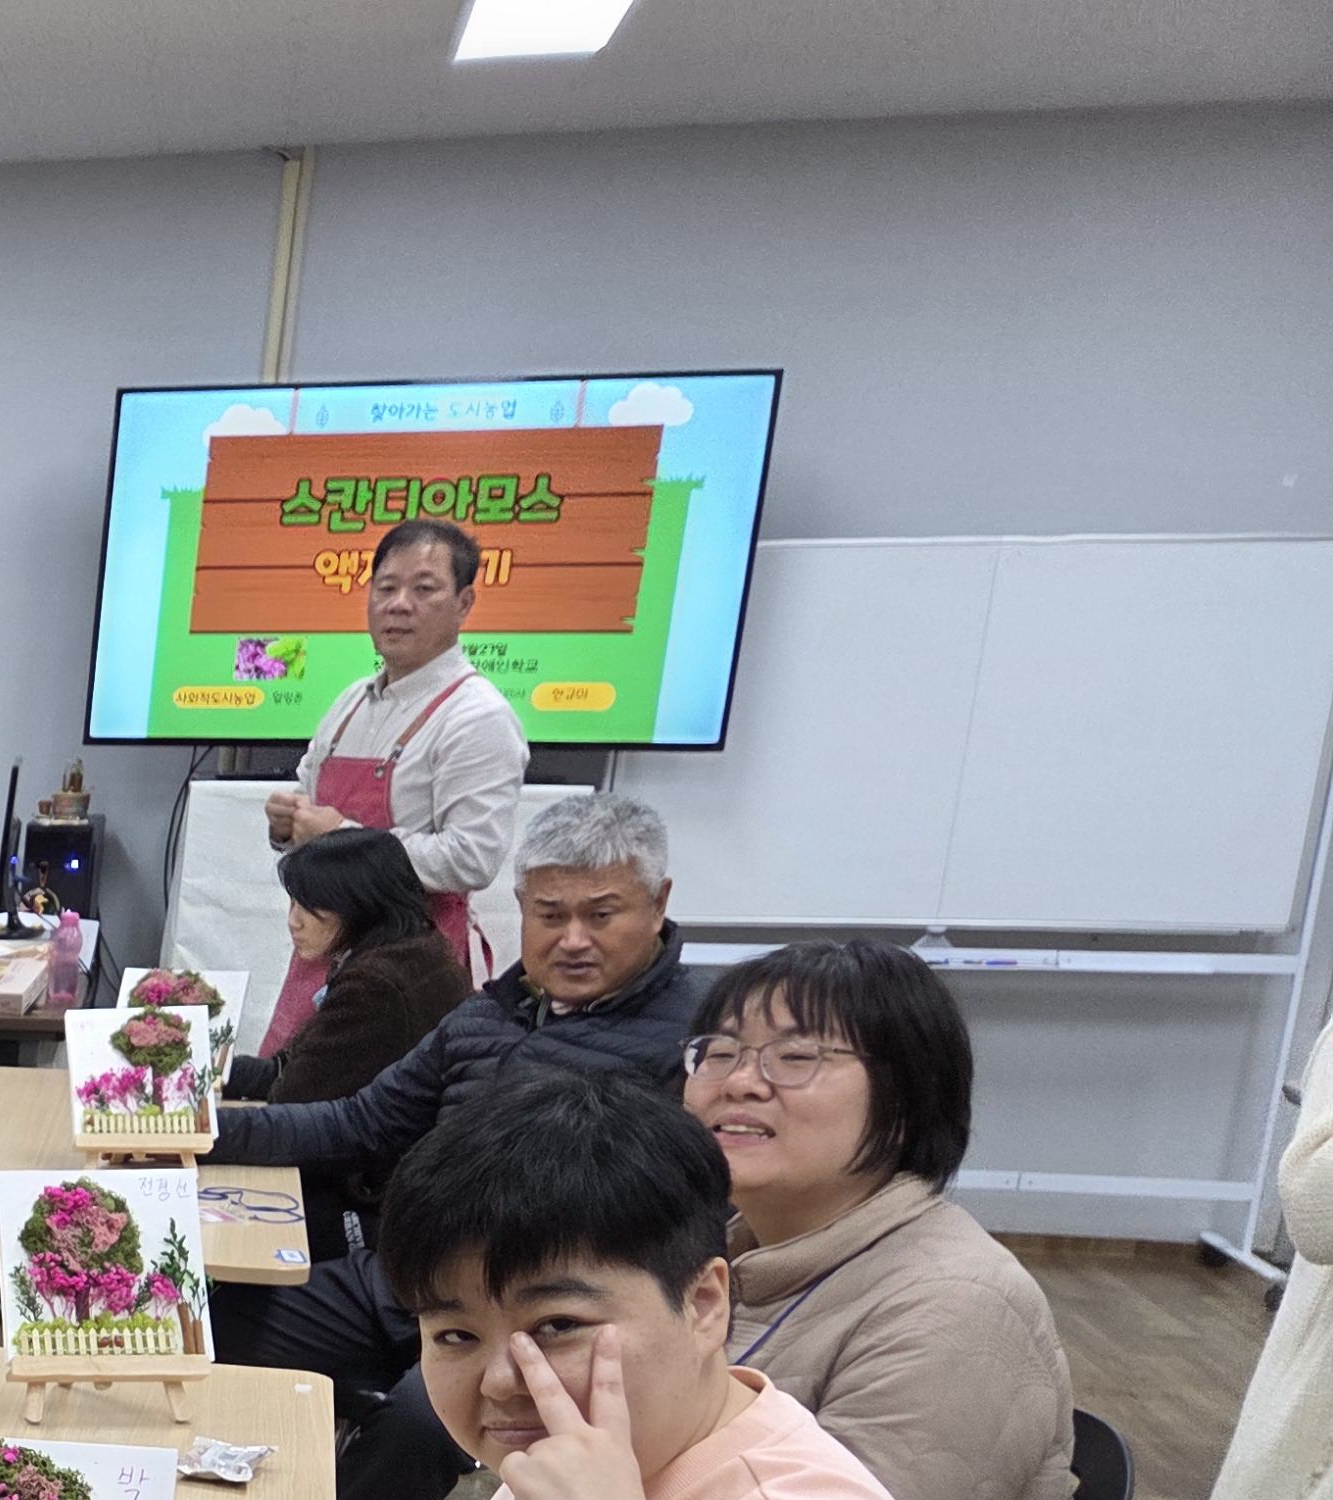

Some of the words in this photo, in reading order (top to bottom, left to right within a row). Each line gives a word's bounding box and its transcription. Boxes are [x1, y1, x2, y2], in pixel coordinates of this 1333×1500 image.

[371, 401, 439, 423] 찾아가는
[447, 399, 517, 420] 도시농업
[280, 472, 563, 533] 스칸디아모스
